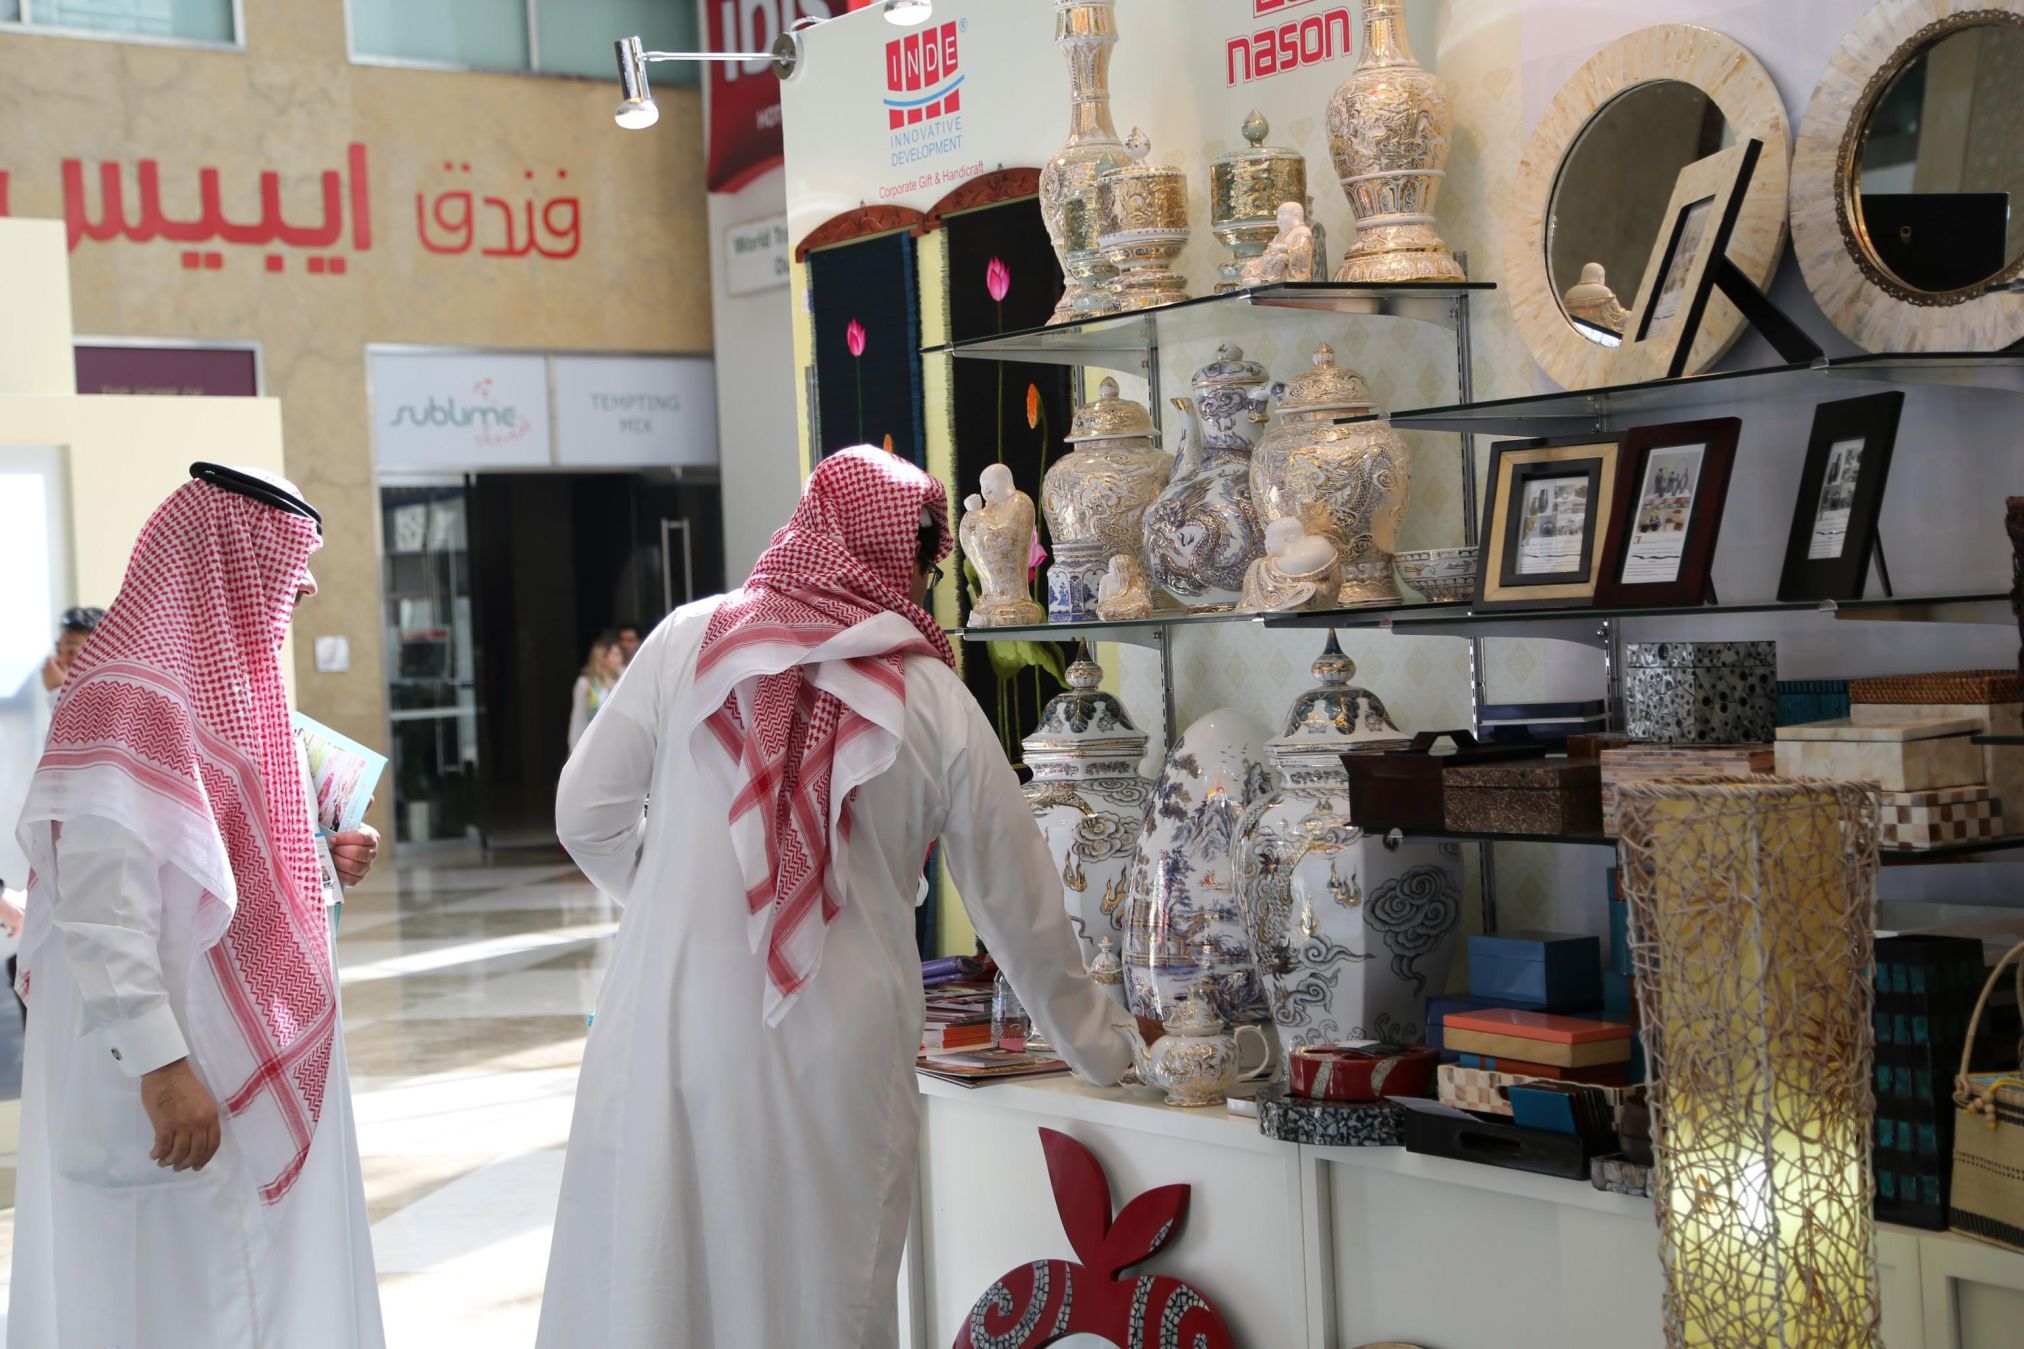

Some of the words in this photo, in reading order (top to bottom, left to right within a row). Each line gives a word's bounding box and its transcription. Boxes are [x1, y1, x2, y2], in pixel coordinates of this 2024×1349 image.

[892, 36, 958, 82] INDE
[1226, 7, 1352, 87] nason
[890, 116, 963, 149] INNOVATIVE
[891, 134, 963, 167] DEVELOPMENT
[879, 179, 918, 199] Corporate
[919, 174, 934, 188] Gift
[935, 172, 941, 185] &
[943, 160, 984, 183] Handicraft
[417, 161, 581, 260] فندق
